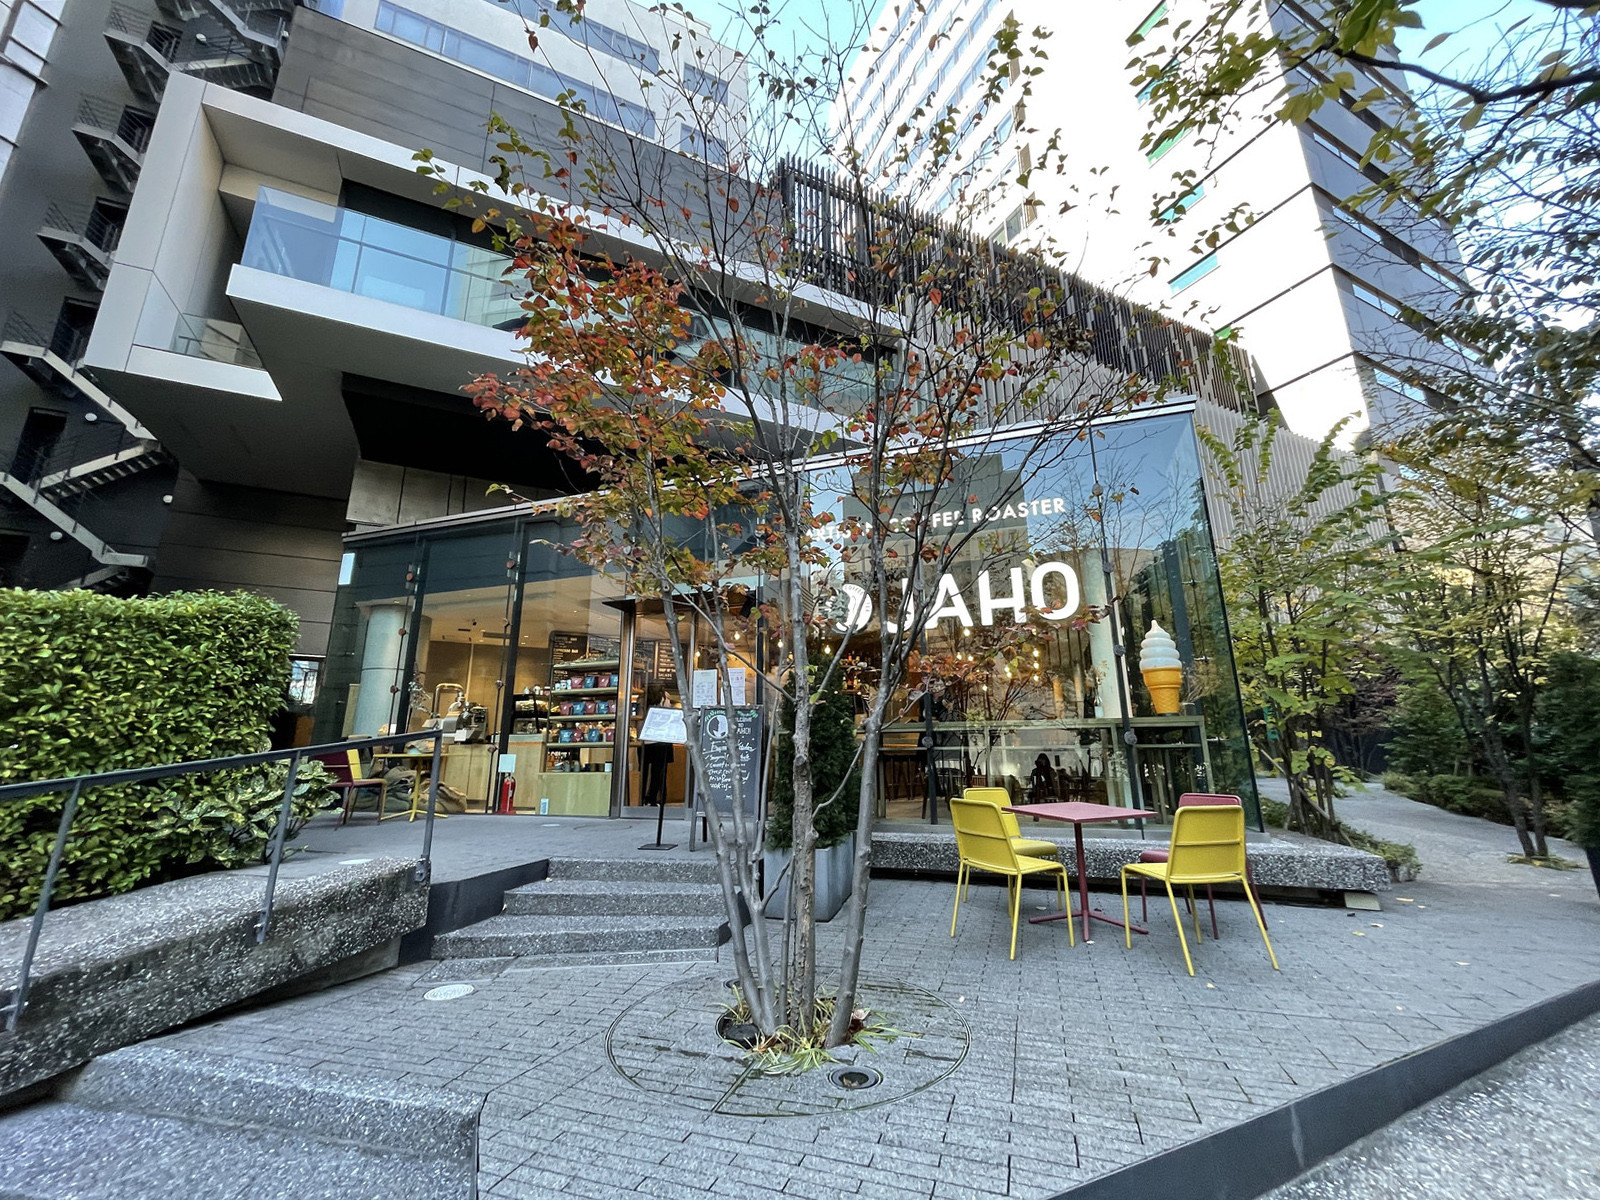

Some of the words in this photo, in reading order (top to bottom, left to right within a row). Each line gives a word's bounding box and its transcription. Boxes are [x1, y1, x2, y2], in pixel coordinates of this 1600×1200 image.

[889, 511, 964, 533] COFEE
[972, 498, 1066, 524] ROASTER
[887, 561, 1080, 634] JAHO
